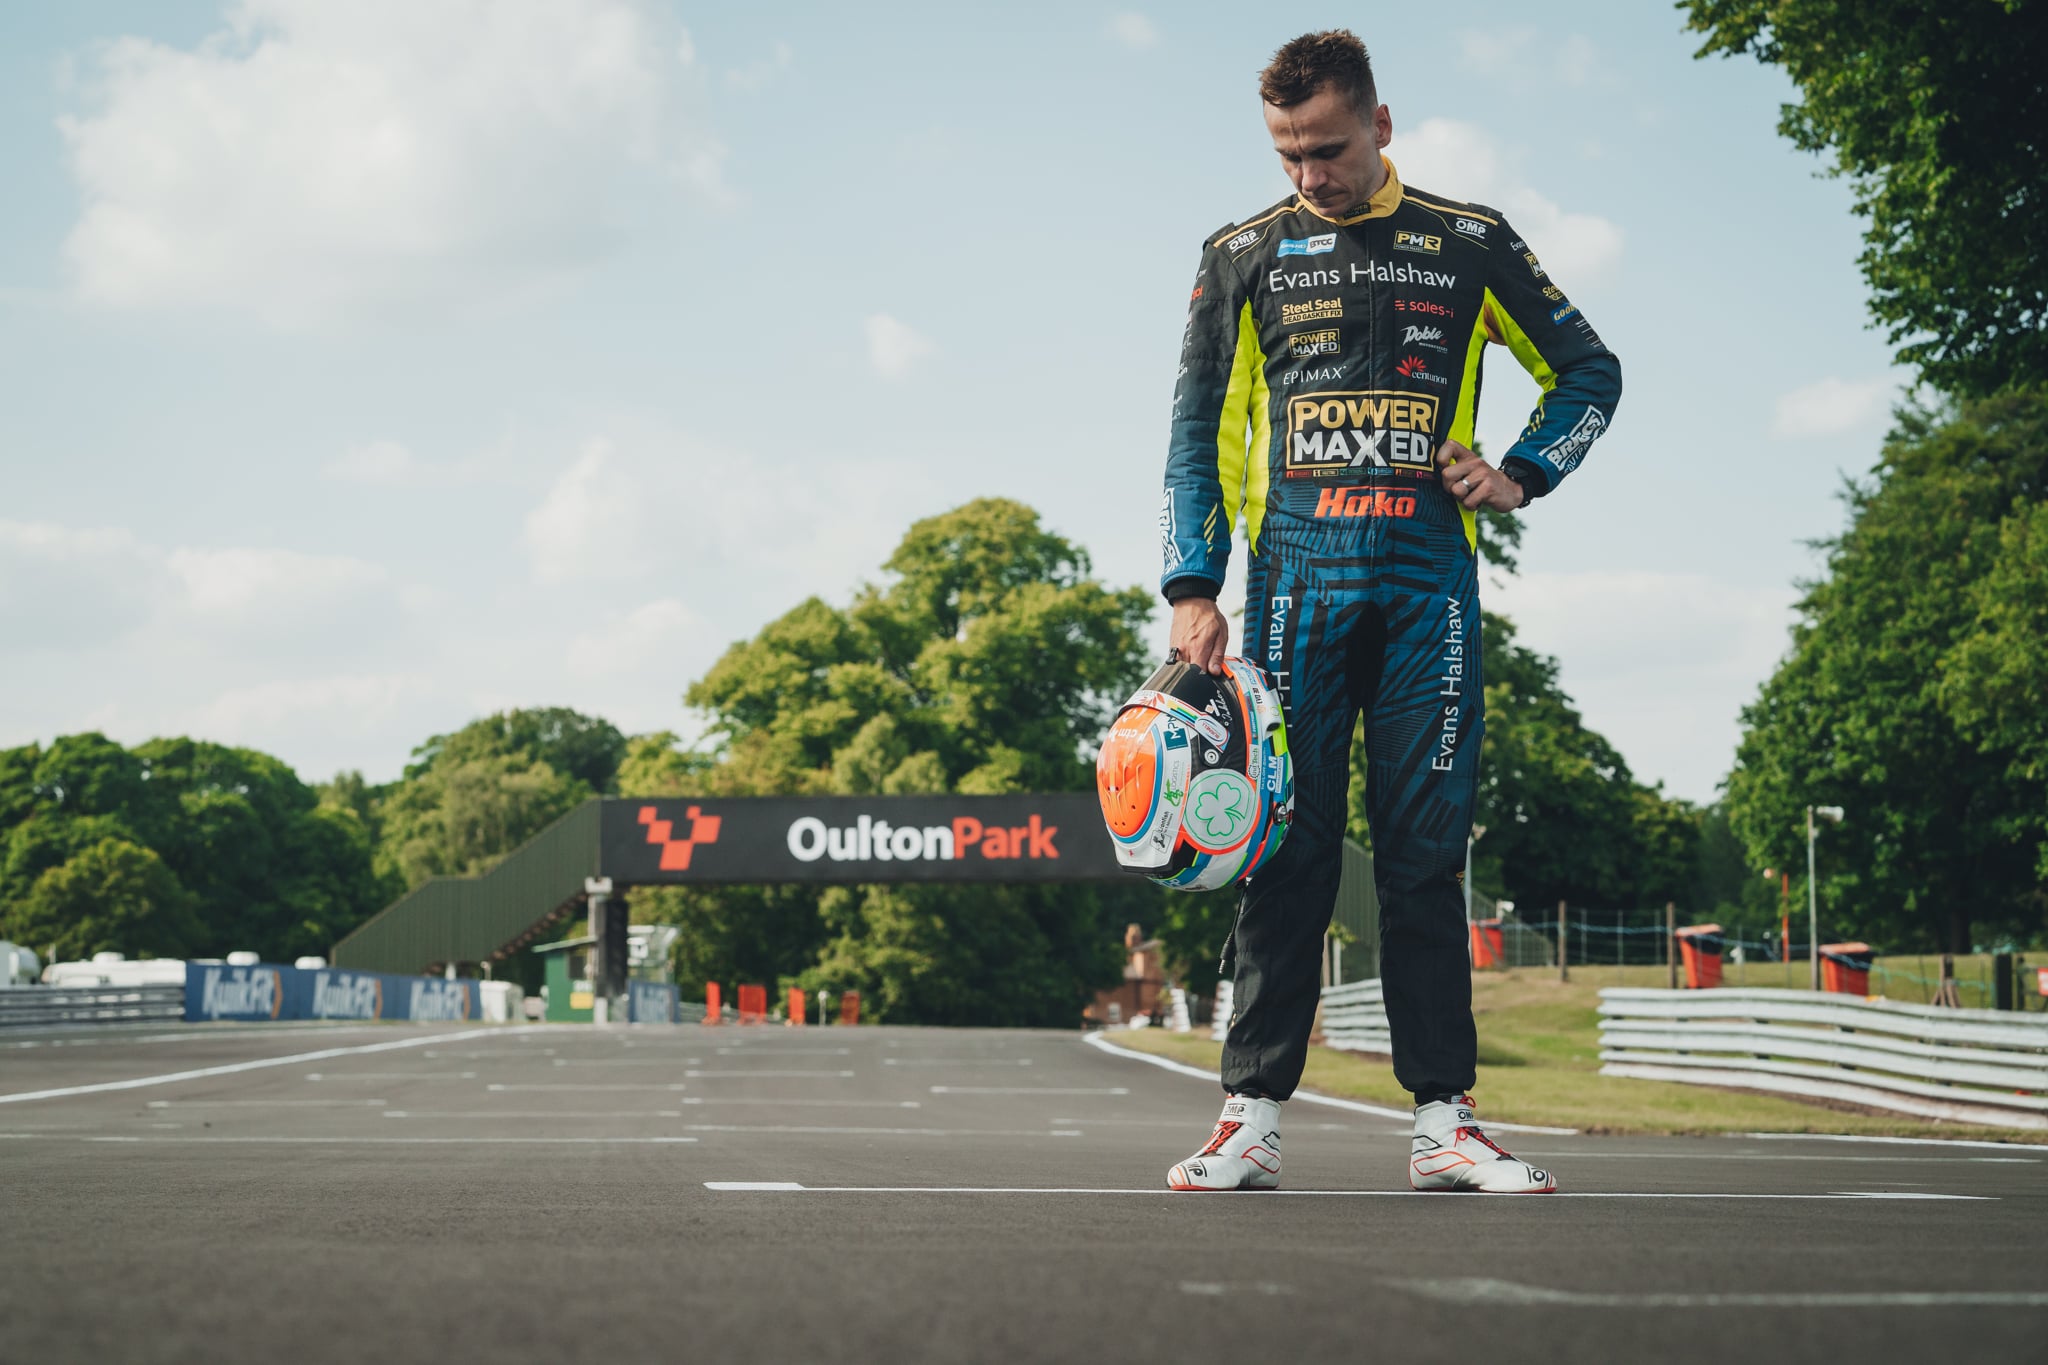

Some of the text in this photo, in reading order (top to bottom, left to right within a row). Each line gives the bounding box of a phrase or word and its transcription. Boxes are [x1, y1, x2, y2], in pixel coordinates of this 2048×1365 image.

[1456, 220, 1486, 235] OMP
[1229, 232, 1257, 251] OMP
[1310, 238, 1333, 249] BTCC
[1397, 233, 1438, 249] PMR
[1269, 260, 1456, 292] Evans Halshaw
[1282, 297, 1342, 316] Steel Seal
[1409, 301, 1454, 318] sales-i
[1284, 315, 1301, 324] HEAD
[1302, 311, 1329, 320] GASKET
[1292, 332, 1337, 346] POWER
[1292, 342, 1338, 355] MAXED
[1283, 367, 1342, 385] EPIMAX
[1412, 371, 1448, 385] centurion
[1294, 399, 1431, 433] POWER
[1294, 430, 1429, 467] MAXED
[1546, 413, 1601, 467] BRIGGS
[1314, 486, 1417, 518] Hako
[1269, 596, 1293, 662] Evans
[1432, 597, 1463, 771] Evans Halshaw
[1267, 756, 1277, 791] CLM
[1458, 1111, 1474, 1120] OM
